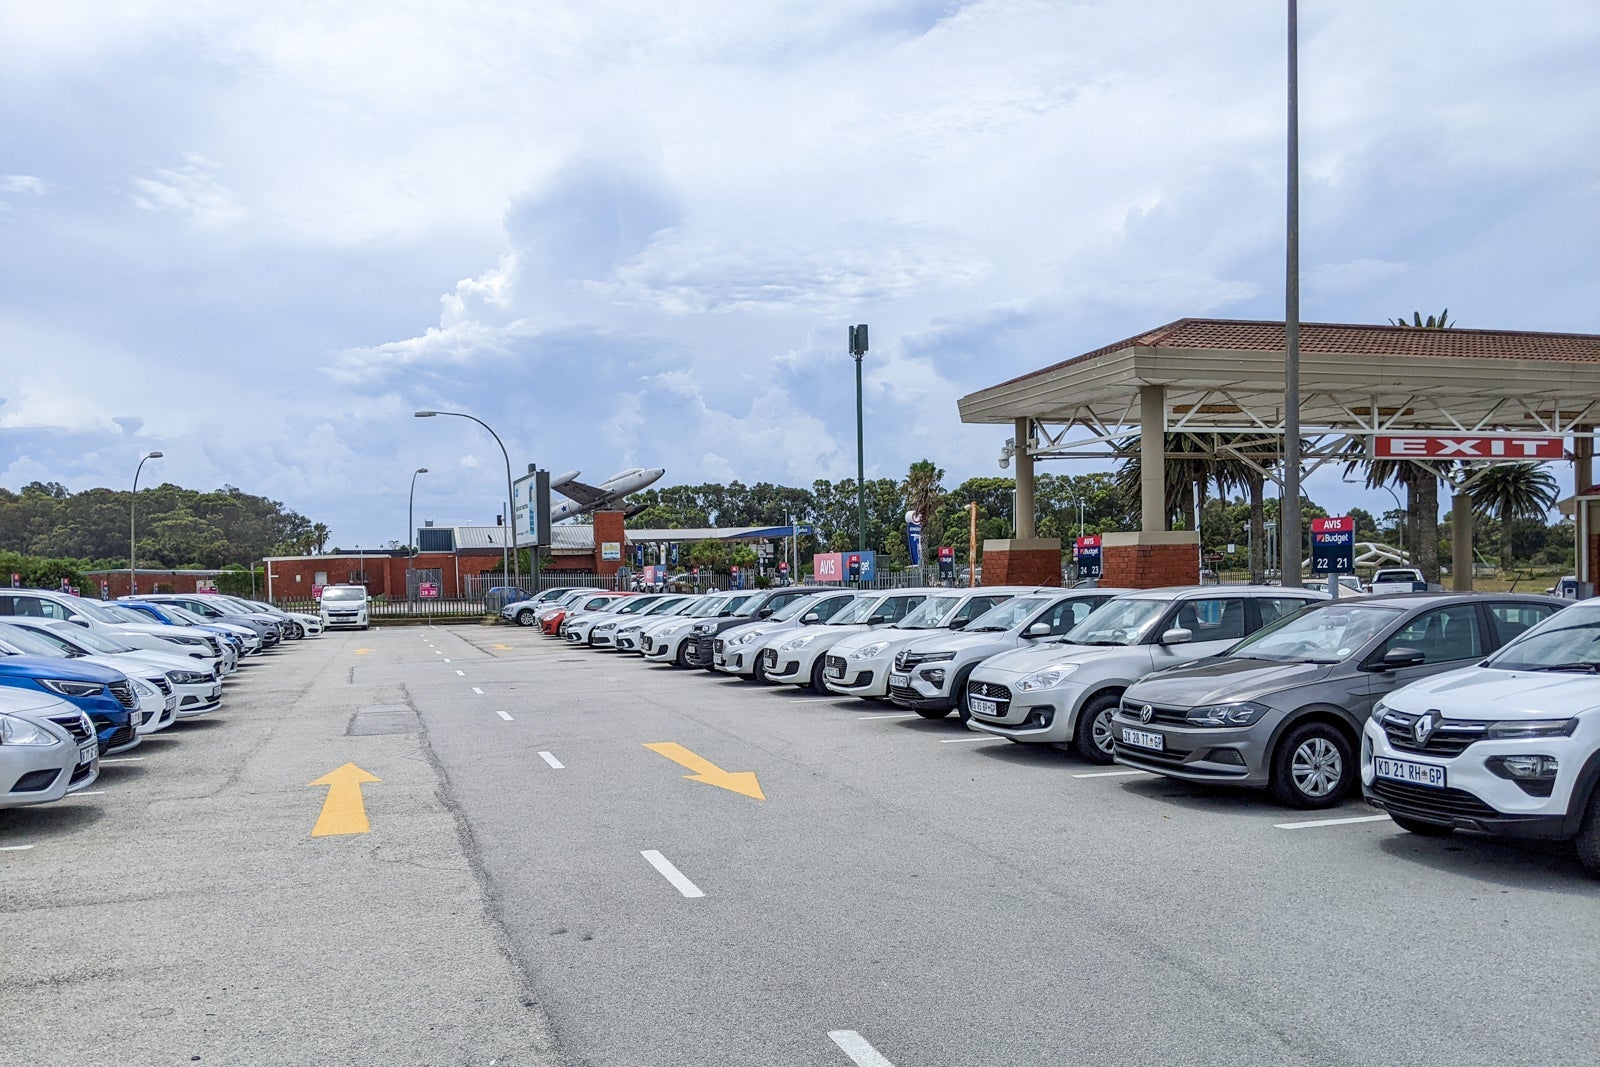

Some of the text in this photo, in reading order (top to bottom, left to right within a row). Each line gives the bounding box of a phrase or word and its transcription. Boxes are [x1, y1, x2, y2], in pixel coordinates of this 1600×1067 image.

[1389, 438, 1549, 456] EXIT
[1323, 519, 1342, 530] AVIS
[1083, 537, 1095, 545] AVIS
[1324, 533, 1349, 545] Budget
[1083, 547, 1099, 557] Budget
[819, 559, 835, 575] AVIS
[1317, 557, 1348, 569] 22 21
[1080, 565, 1099, 575] 24 23
[1132, 732, 1140, 744] 28
[1141, 733, 1149, 746] TT
[1154, 736, 1162, 749] GP
[1378, 760, 1442, 785] KD 21 RH GP
